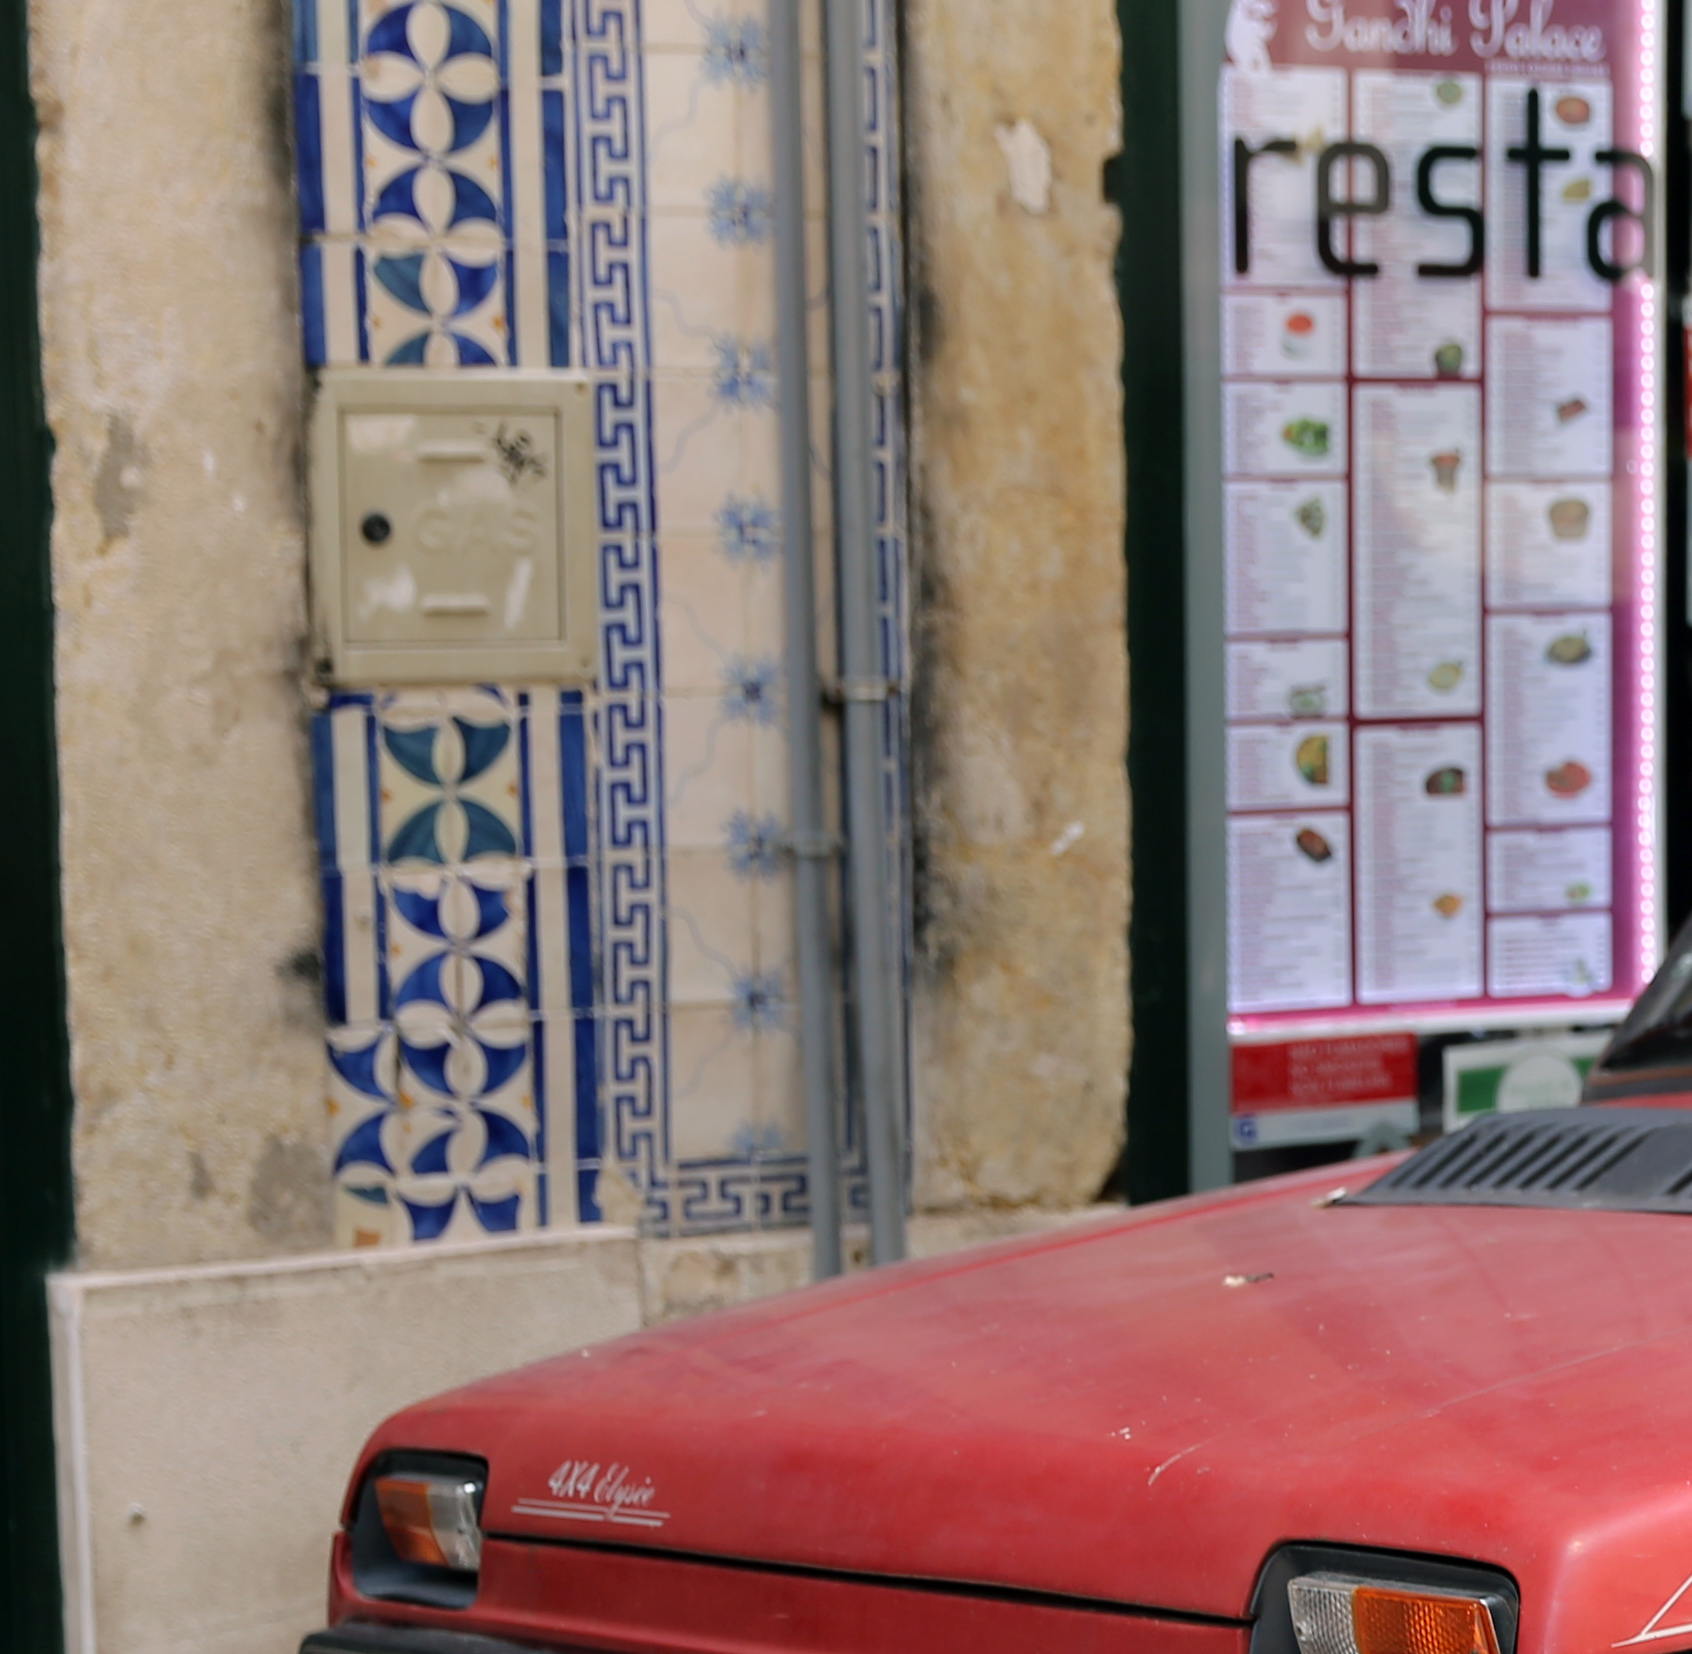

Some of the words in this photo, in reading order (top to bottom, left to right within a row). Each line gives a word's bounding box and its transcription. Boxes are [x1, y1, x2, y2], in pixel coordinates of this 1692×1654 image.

[1469, 0, 1606, 61] Palace
[1233, 86, 1655, 281] resta
[413, 504, 541, 557] GAS
